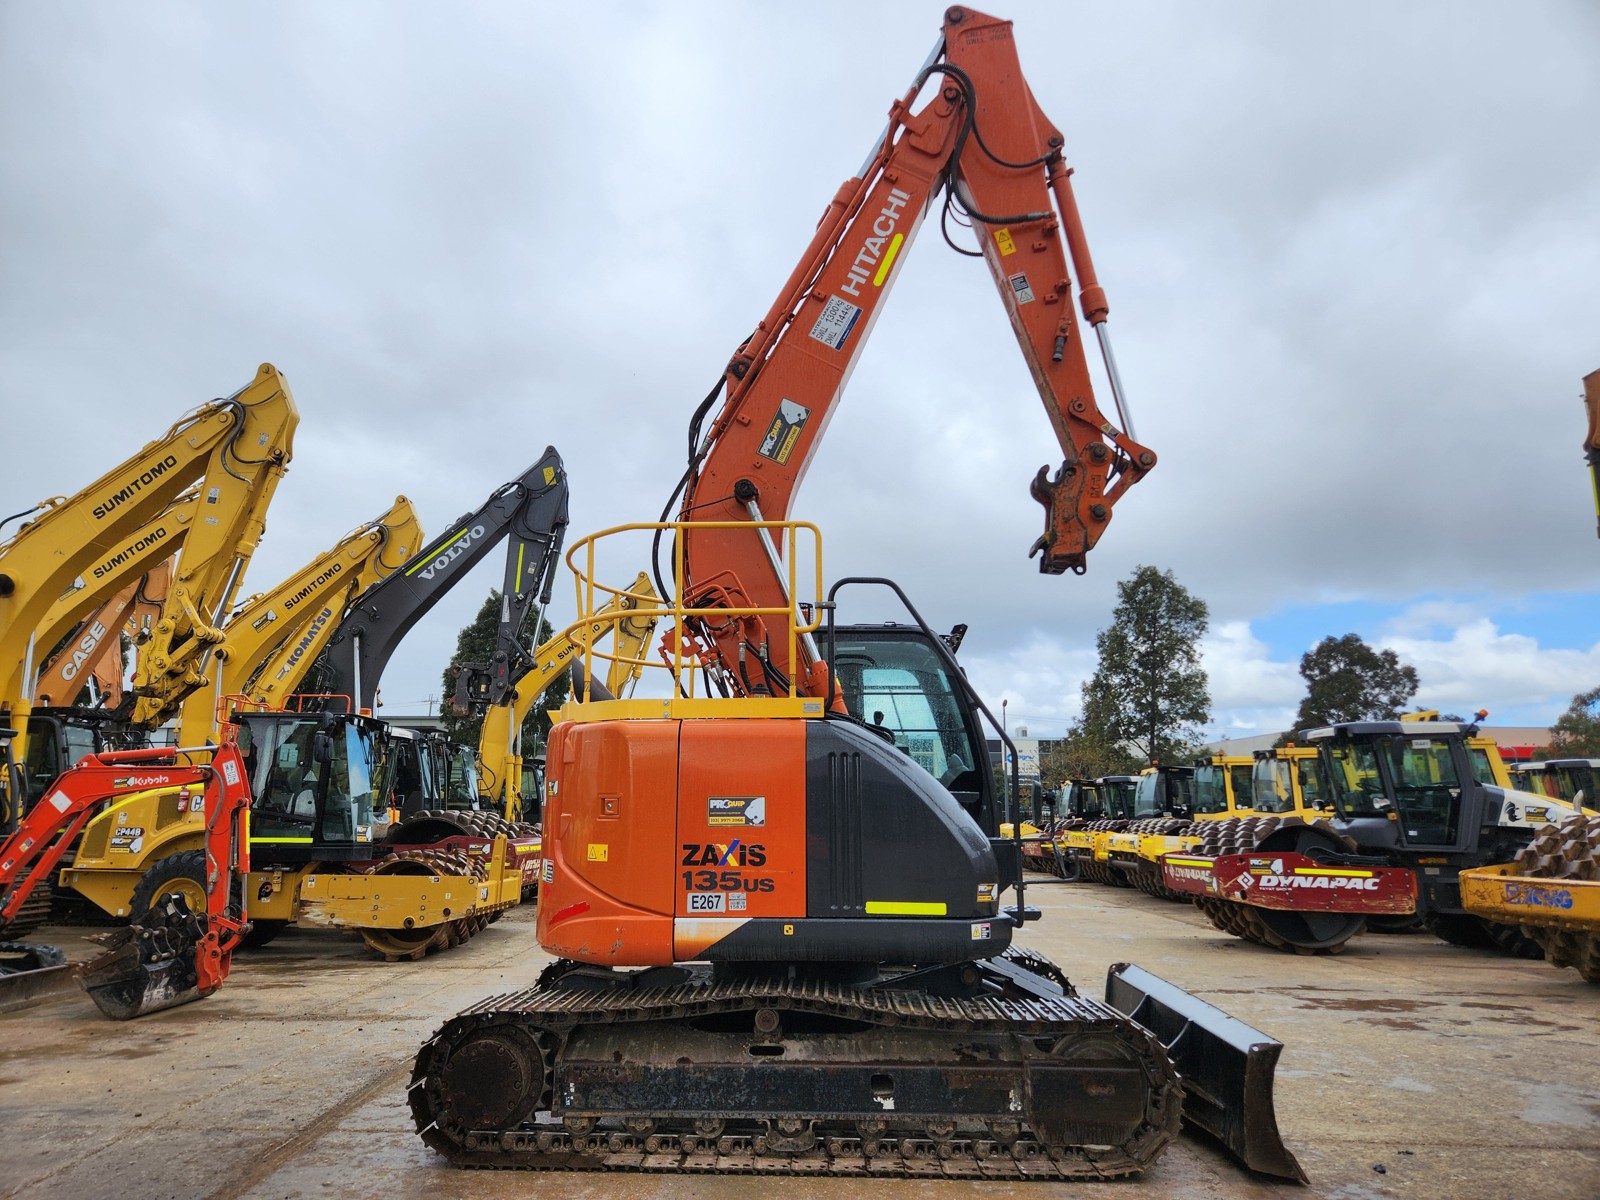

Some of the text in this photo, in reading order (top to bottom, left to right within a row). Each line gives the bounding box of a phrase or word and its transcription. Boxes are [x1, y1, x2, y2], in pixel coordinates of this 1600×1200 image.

[840, 188, 911, 297] HITACHI
[92, 455, 178, 520] SUMITOMO
[93, 527, 167, 579] SUMITOMO
[417, 525, 485, 580] VOLVO
[284, 563, 342, 610] SUMITOMO
[61, 621, 106, 681] CASE
[287, 607, 332, 667] KOMATSU
[135, 775, 169, 786] Kubota
[115, 828, 142, 836] CP44B
[682, 838, 767, 867] ZAXIS
[691, 894, 722, 910] E267
[1259, 875, 1380, 890] DYNAPAC
